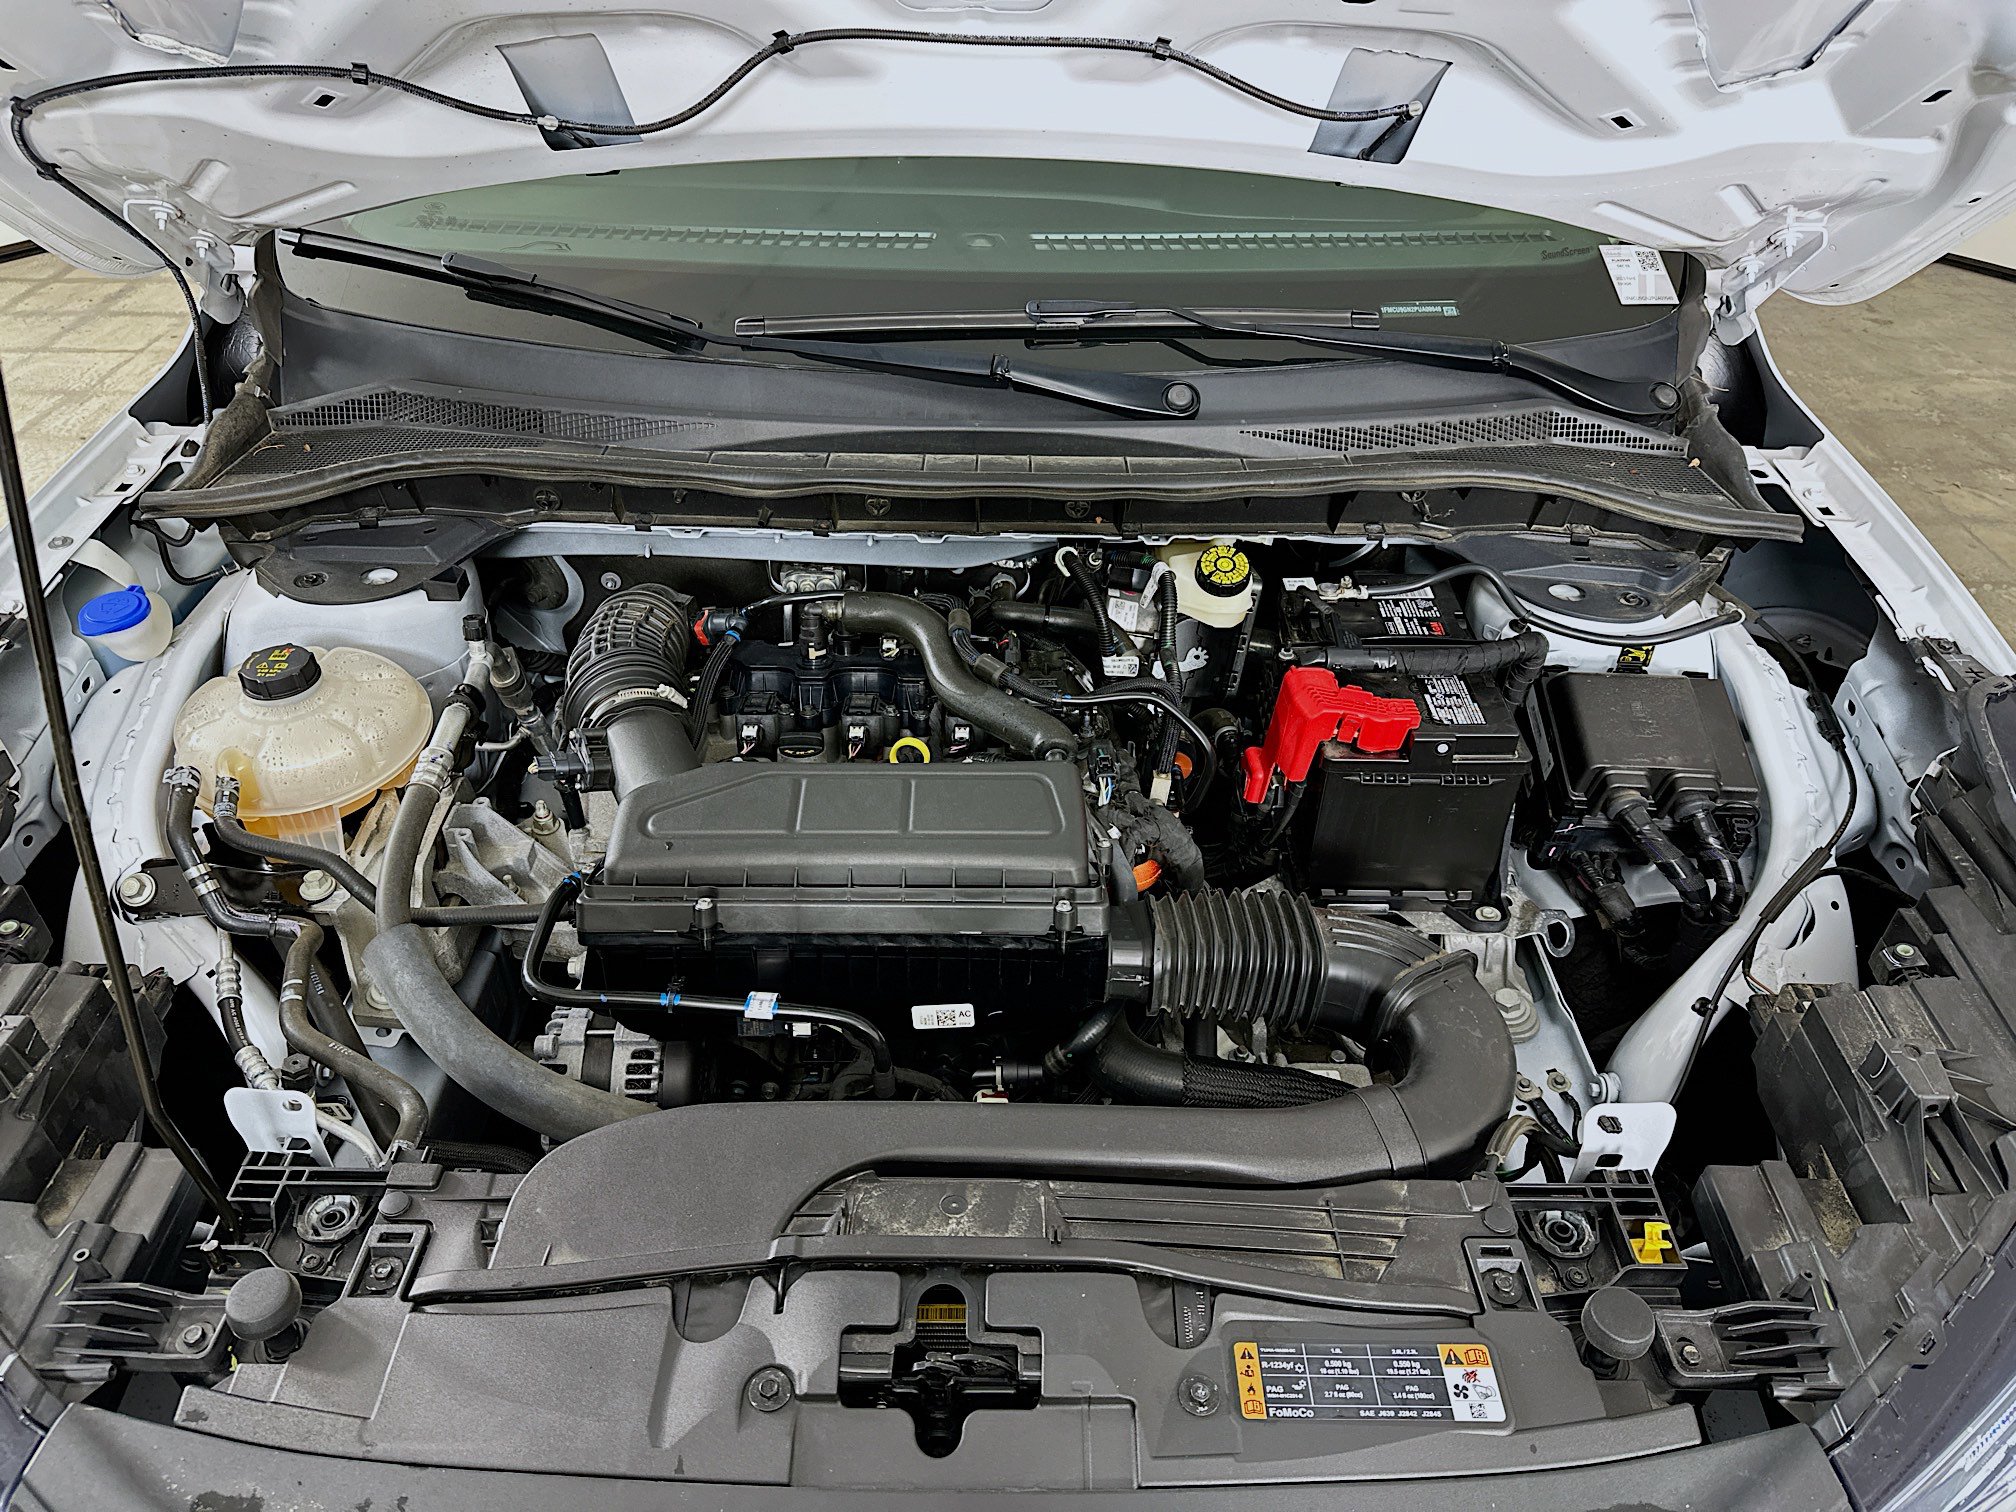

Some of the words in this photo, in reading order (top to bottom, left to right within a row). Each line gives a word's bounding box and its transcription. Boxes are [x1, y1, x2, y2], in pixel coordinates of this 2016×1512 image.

[959, 1010, 972, 1018] AC
[1261, 1361, 1294, 1370] R-1234yf
[1342, 1360, 1352, 1369] kg
[1411, 1360, 1421, 1369] kg
[1266, 1385, 1284, 1393] PAG
[1268, 1408, 1314, 1417] FoMoCo
